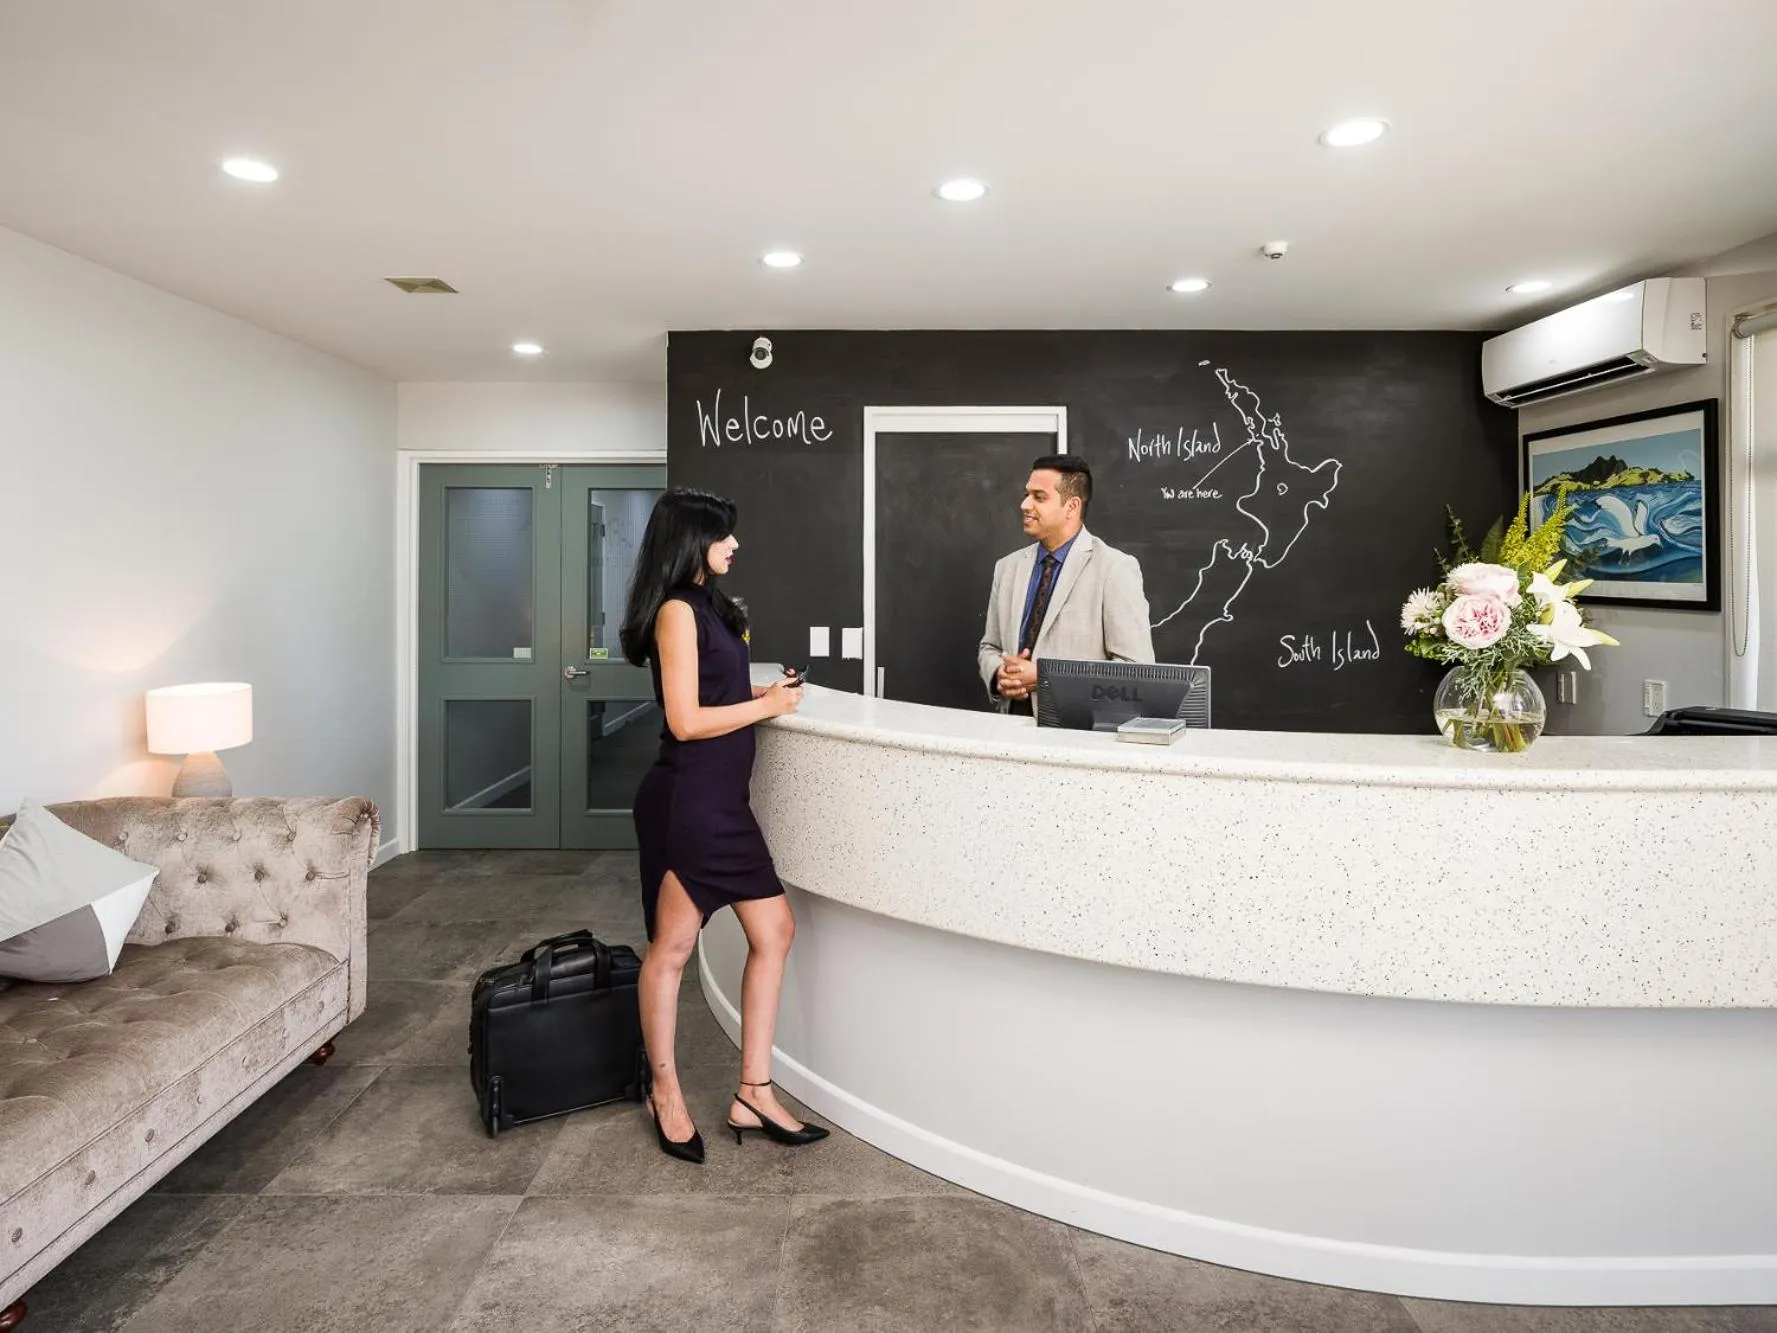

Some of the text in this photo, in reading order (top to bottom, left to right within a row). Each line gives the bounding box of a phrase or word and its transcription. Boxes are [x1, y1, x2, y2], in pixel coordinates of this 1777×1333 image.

[696, 388, 833, 447] Welcome
[1128, 421, 1221, 462] North Island
[1177, 489, 1195, 499] are
[1196, 487, 1223, 499] here
[1278, 619, 1380, 671] South Island
[1091, 684, 1143, 702] DELL
